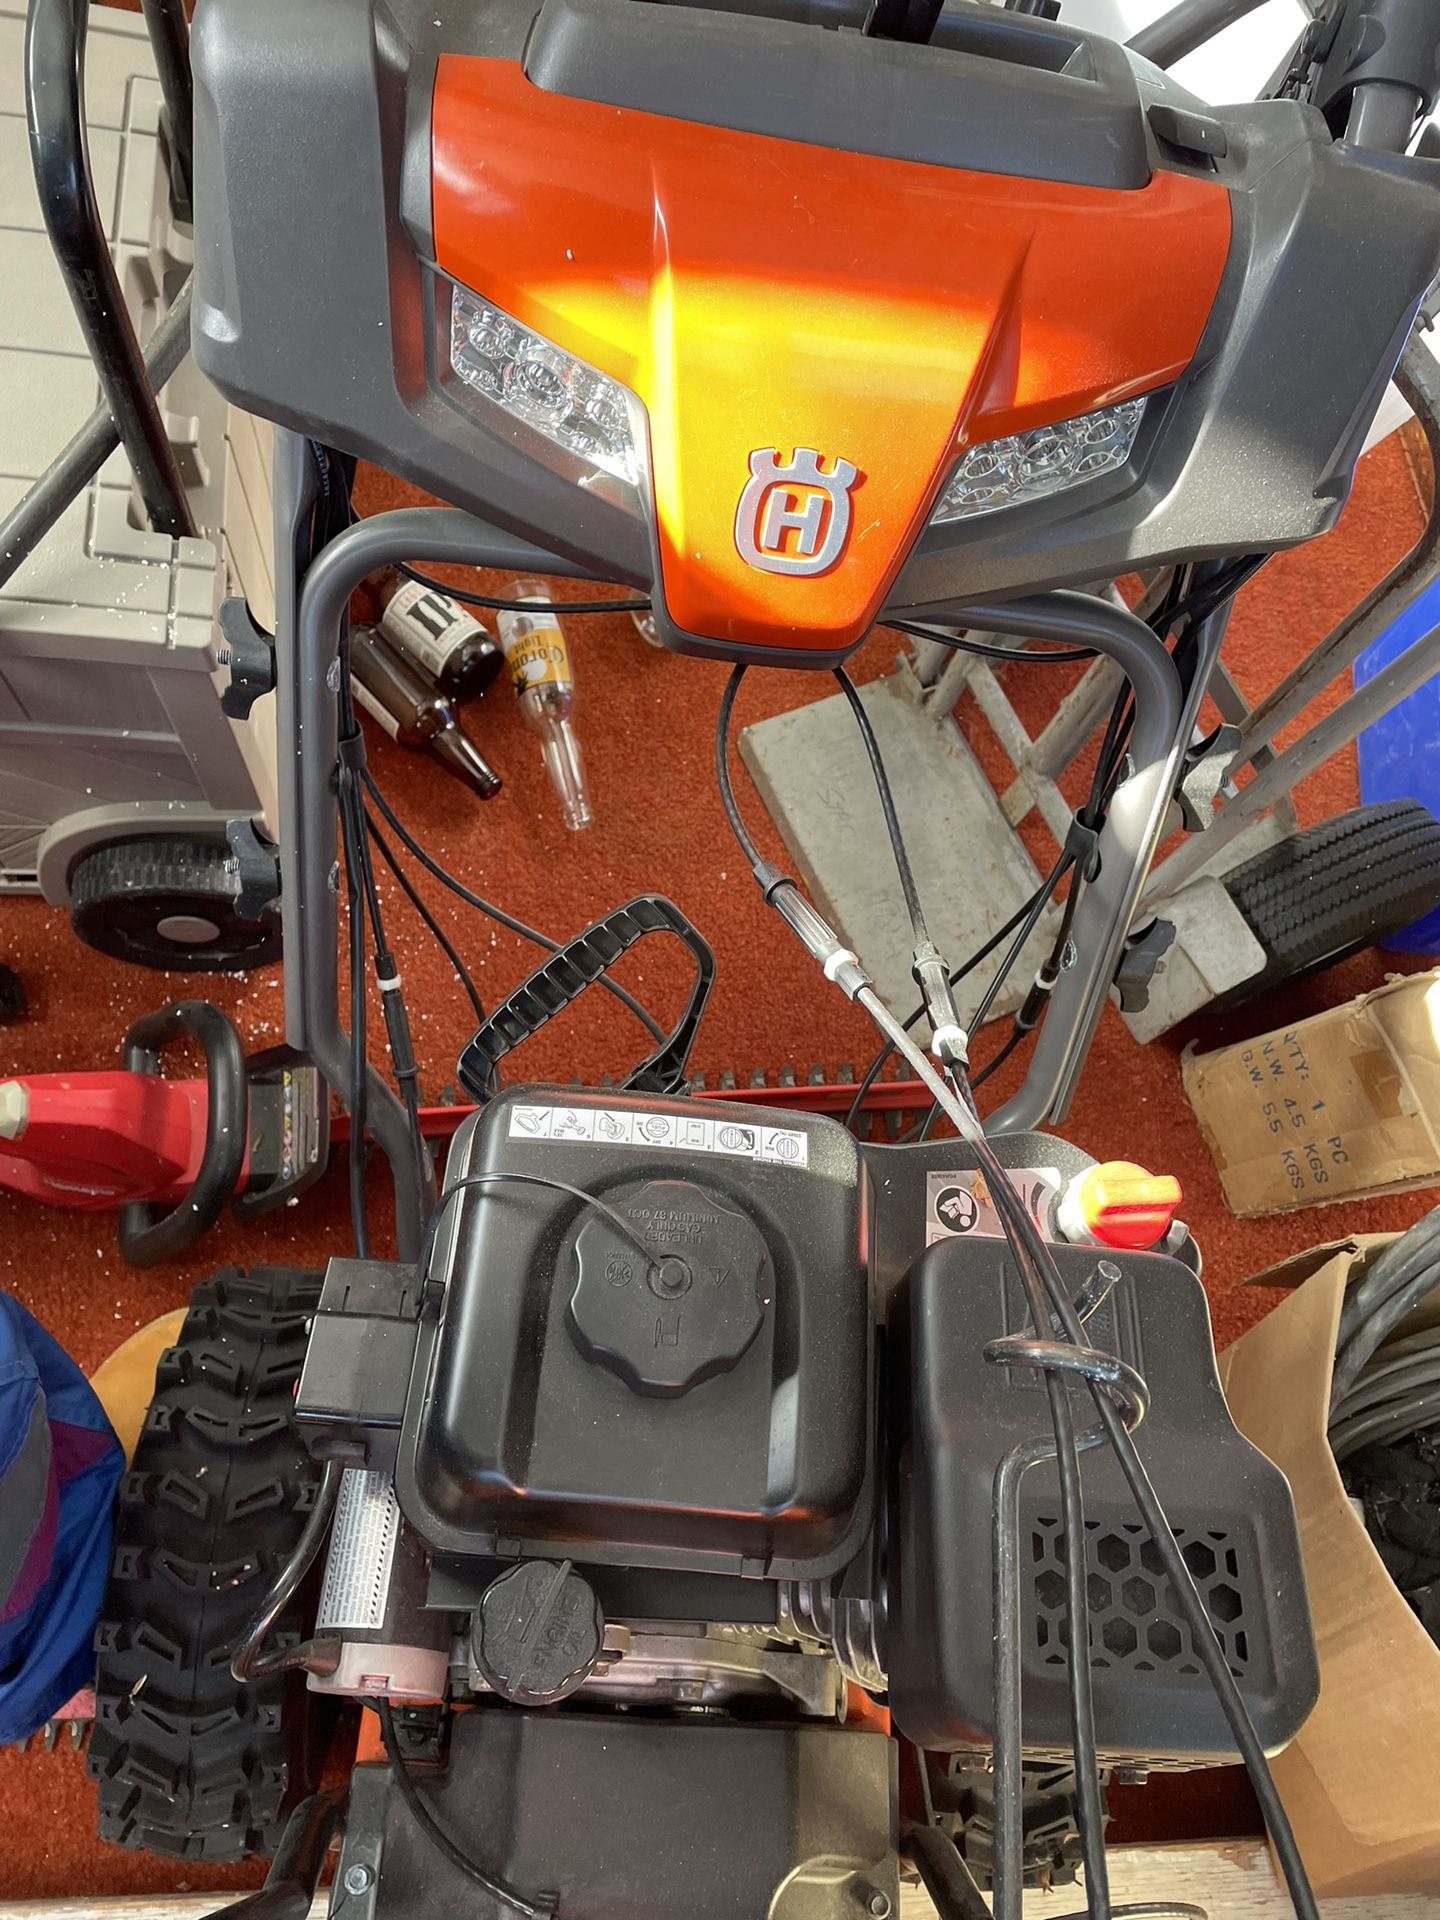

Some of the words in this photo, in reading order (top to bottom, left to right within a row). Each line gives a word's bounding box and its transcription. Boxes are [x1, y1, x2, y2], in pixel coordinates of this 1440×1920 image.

[1241, 1050, 1264, 1089] G.W.
[1263, 1102, 1284, 1133] 5.5
[1281, 1150, 1305, 1190] KGS
[1262, 1041, 1285, 1082] N.W.
[1284, 1098, 1306, 1129] 4.5
[1304, 1144, 1329, 1184] KGS
[1312, 1100, 1326, 1111] 1
[1328, 1136, 1350, 1165] PC
